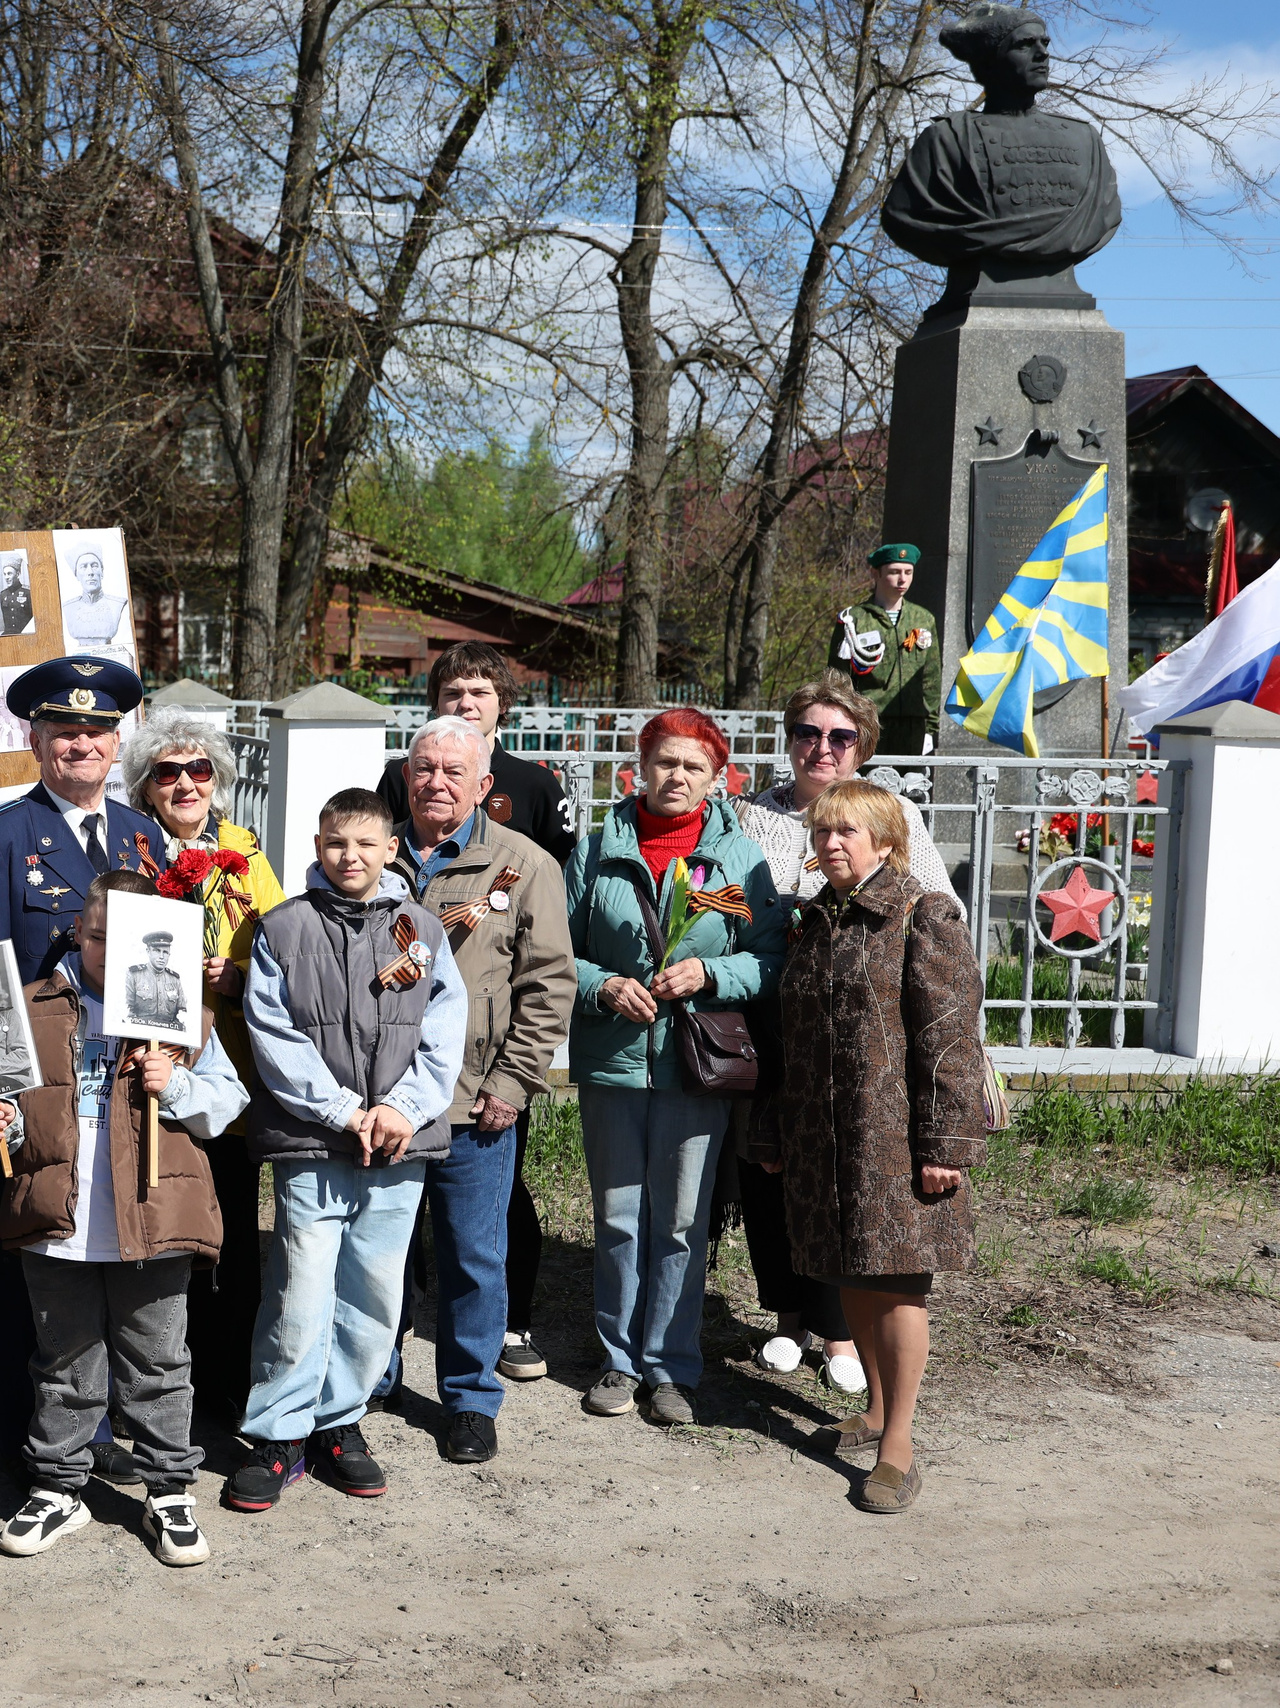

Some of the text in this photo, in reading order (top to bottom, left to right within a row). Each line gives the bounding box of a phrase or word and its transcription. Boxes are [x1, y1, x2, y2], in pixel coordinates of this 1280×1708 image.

[1025, 463, 1058, 475] УКАЗ
[410, 943, 420, 955] 9
[89, 1120, 108, 1130] EST.
